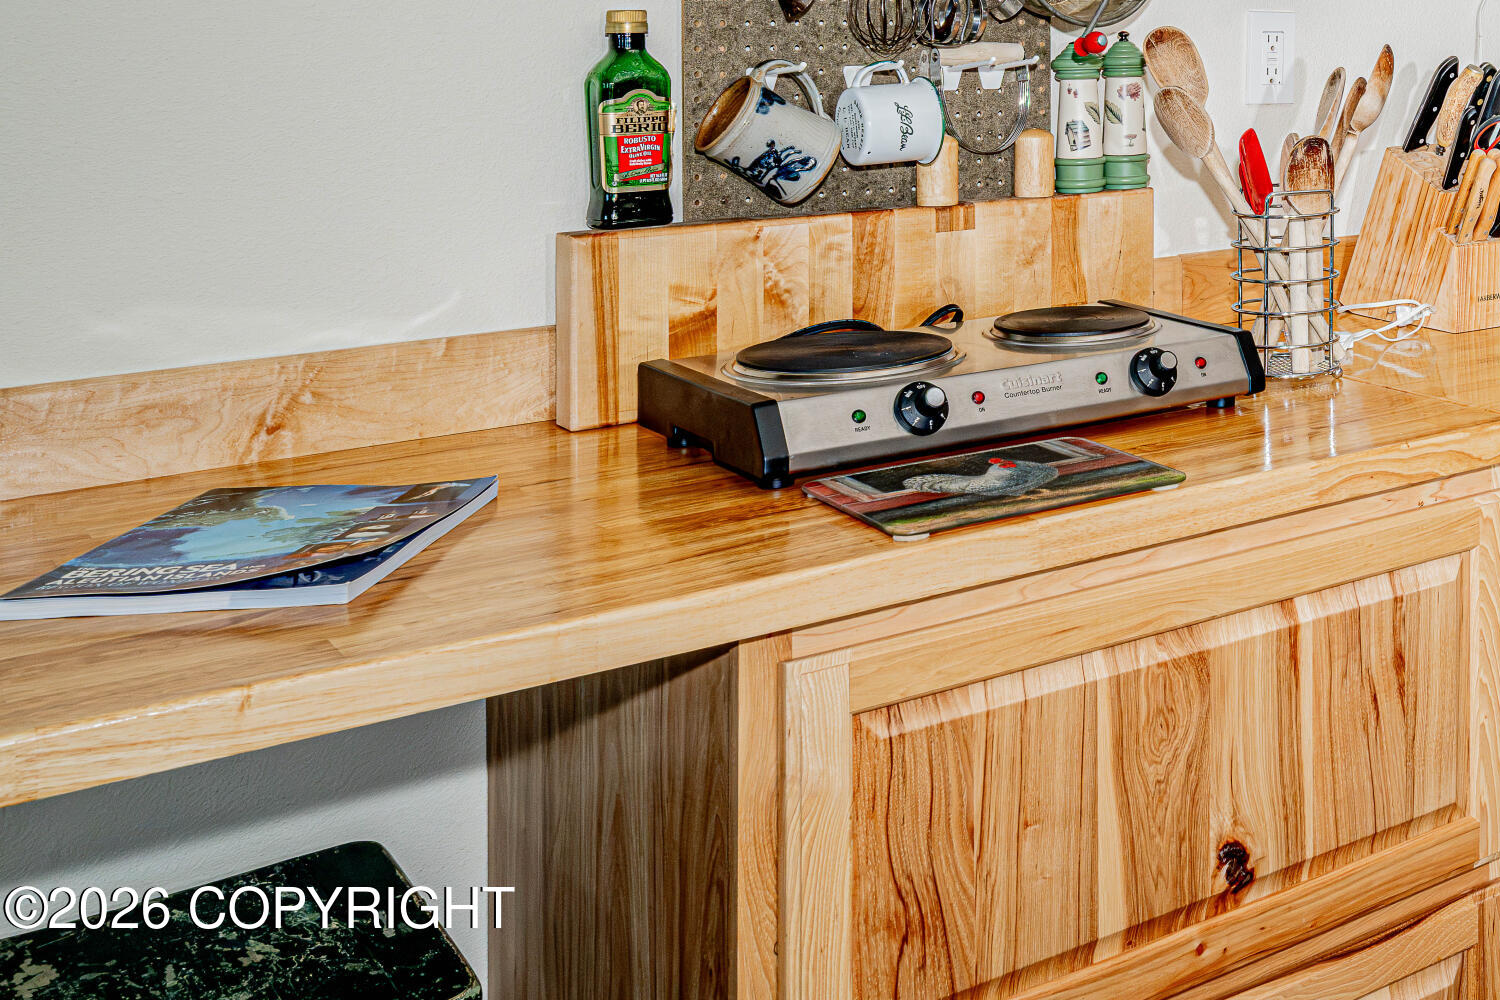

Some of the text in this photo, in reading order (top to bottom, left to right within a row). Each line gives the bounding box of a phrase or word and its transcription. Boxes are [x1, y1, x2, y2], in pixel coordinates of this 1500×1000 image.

[616, 115, 667, 124] FILIPPO
[623, 135, 657, 145] ROBUSTO
[1002, 371, 1063, 390] Cuisinart
[1004, 383, 1063, 399] Countertop Burner
[854, 425, 871, 433] READY
[45, 574, 162, 586] ALEUTIAN
[163, 568, 260, 580] ISLANDS
[61, 565, 181, 579] BERING
[180, 562, 238, 574] SEA
